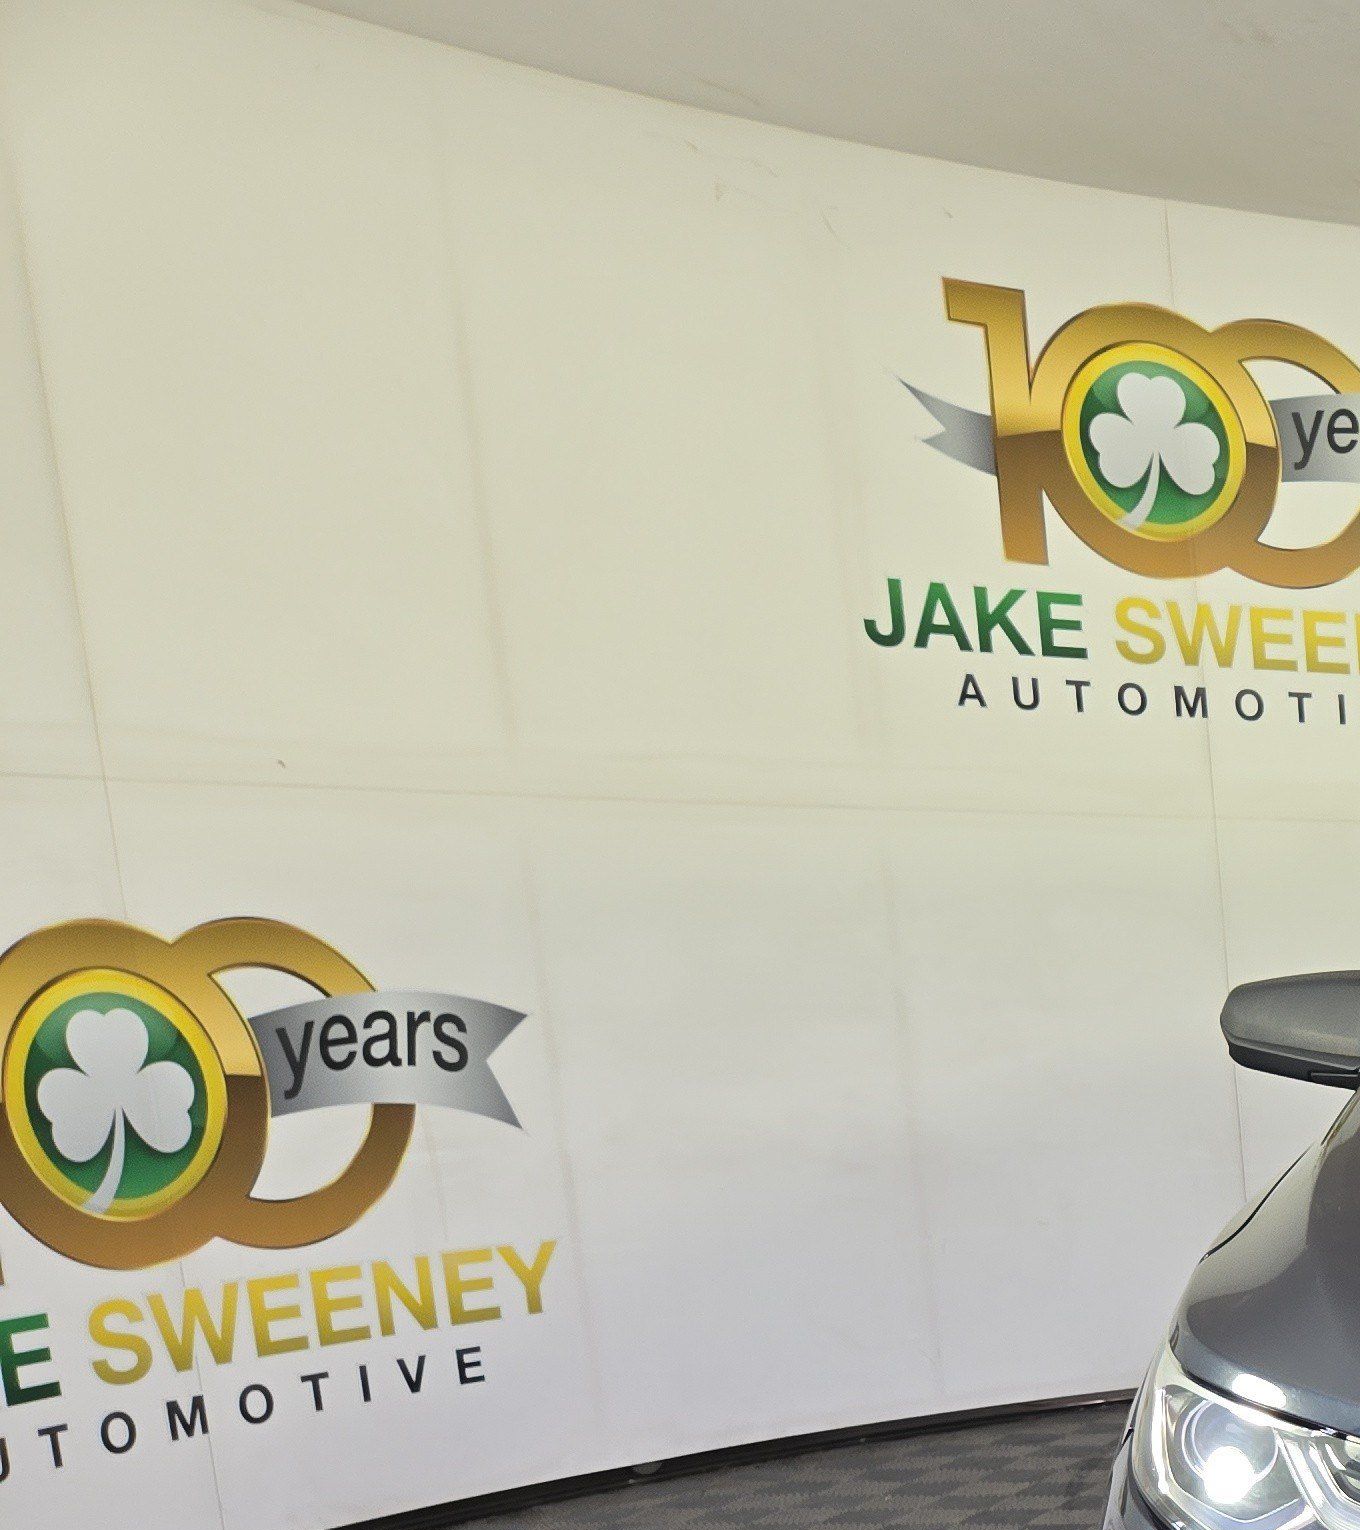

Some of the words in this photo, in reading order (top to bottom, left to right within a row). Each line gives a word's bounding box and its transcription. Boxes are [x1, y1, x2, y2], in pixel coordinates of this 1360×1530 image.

[863, 577, 1088, 660] JAKE
[275, 1008, 469, 1099] years
[88, 1240, 557, 1387] SWEENEY
